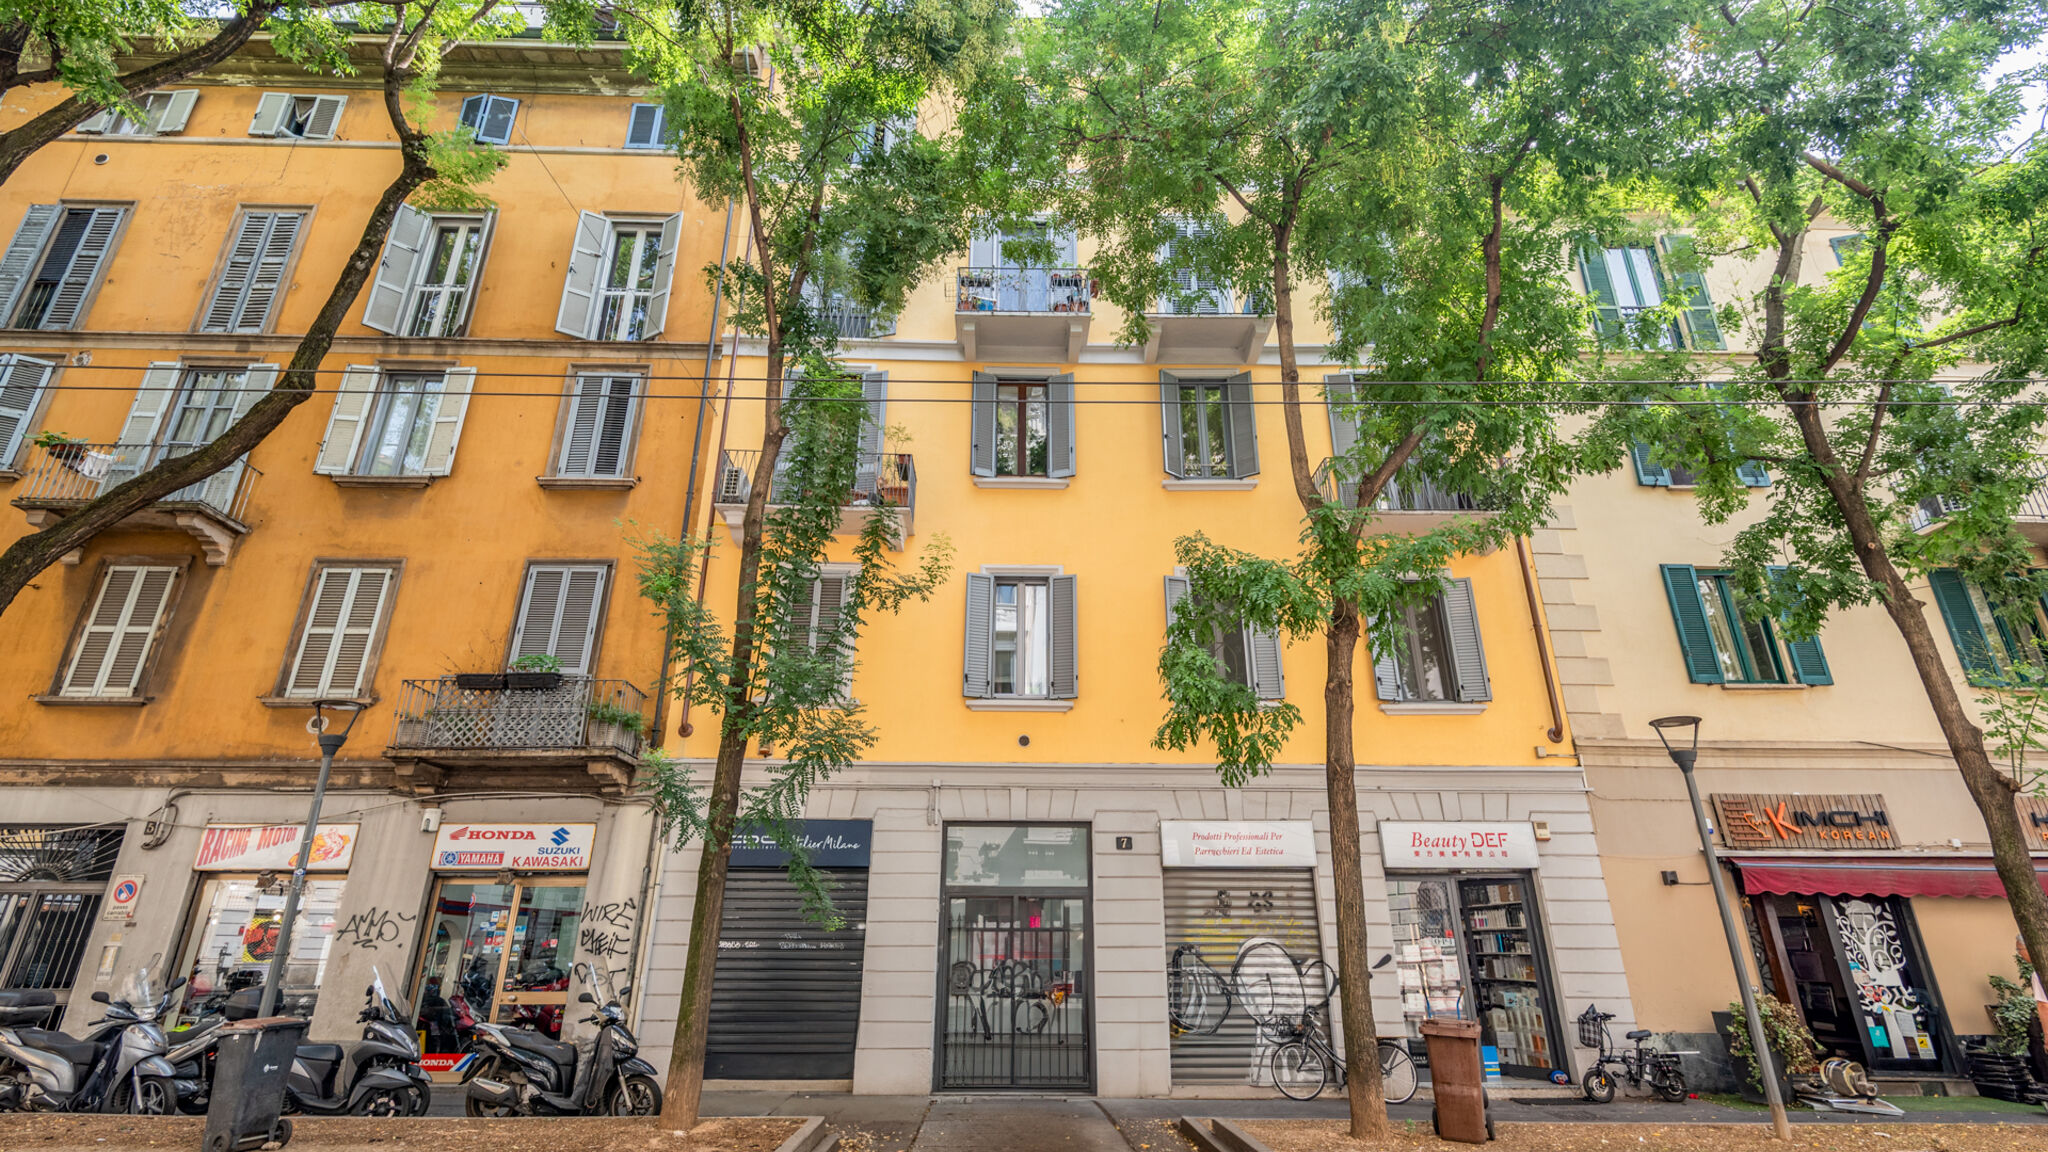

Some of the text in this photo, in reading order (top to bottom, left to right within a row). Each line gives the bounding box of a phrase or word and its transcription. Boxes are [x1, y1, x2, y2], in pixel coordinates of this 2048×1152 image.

[1764, 802, 1889, 840] KIMCHI
[467, 830, 536, 840] HONDA
[1192, 832, 1283, 843] Prodotti Professionali Per
[1819, 830, 1891, 840] KOREAN
[197, 827, 298, 866] RACING MOTOR
[1411, 832, 1508, 854] Beauty DEF
[537, 847, 580, 855] SUZUKI
[1194, 847, 1284, 857] Parrucchieri Ed Estetica
[459, 853, 501, 864] YAMAHA
[512, 856, 584, 867] KAWASAKI
